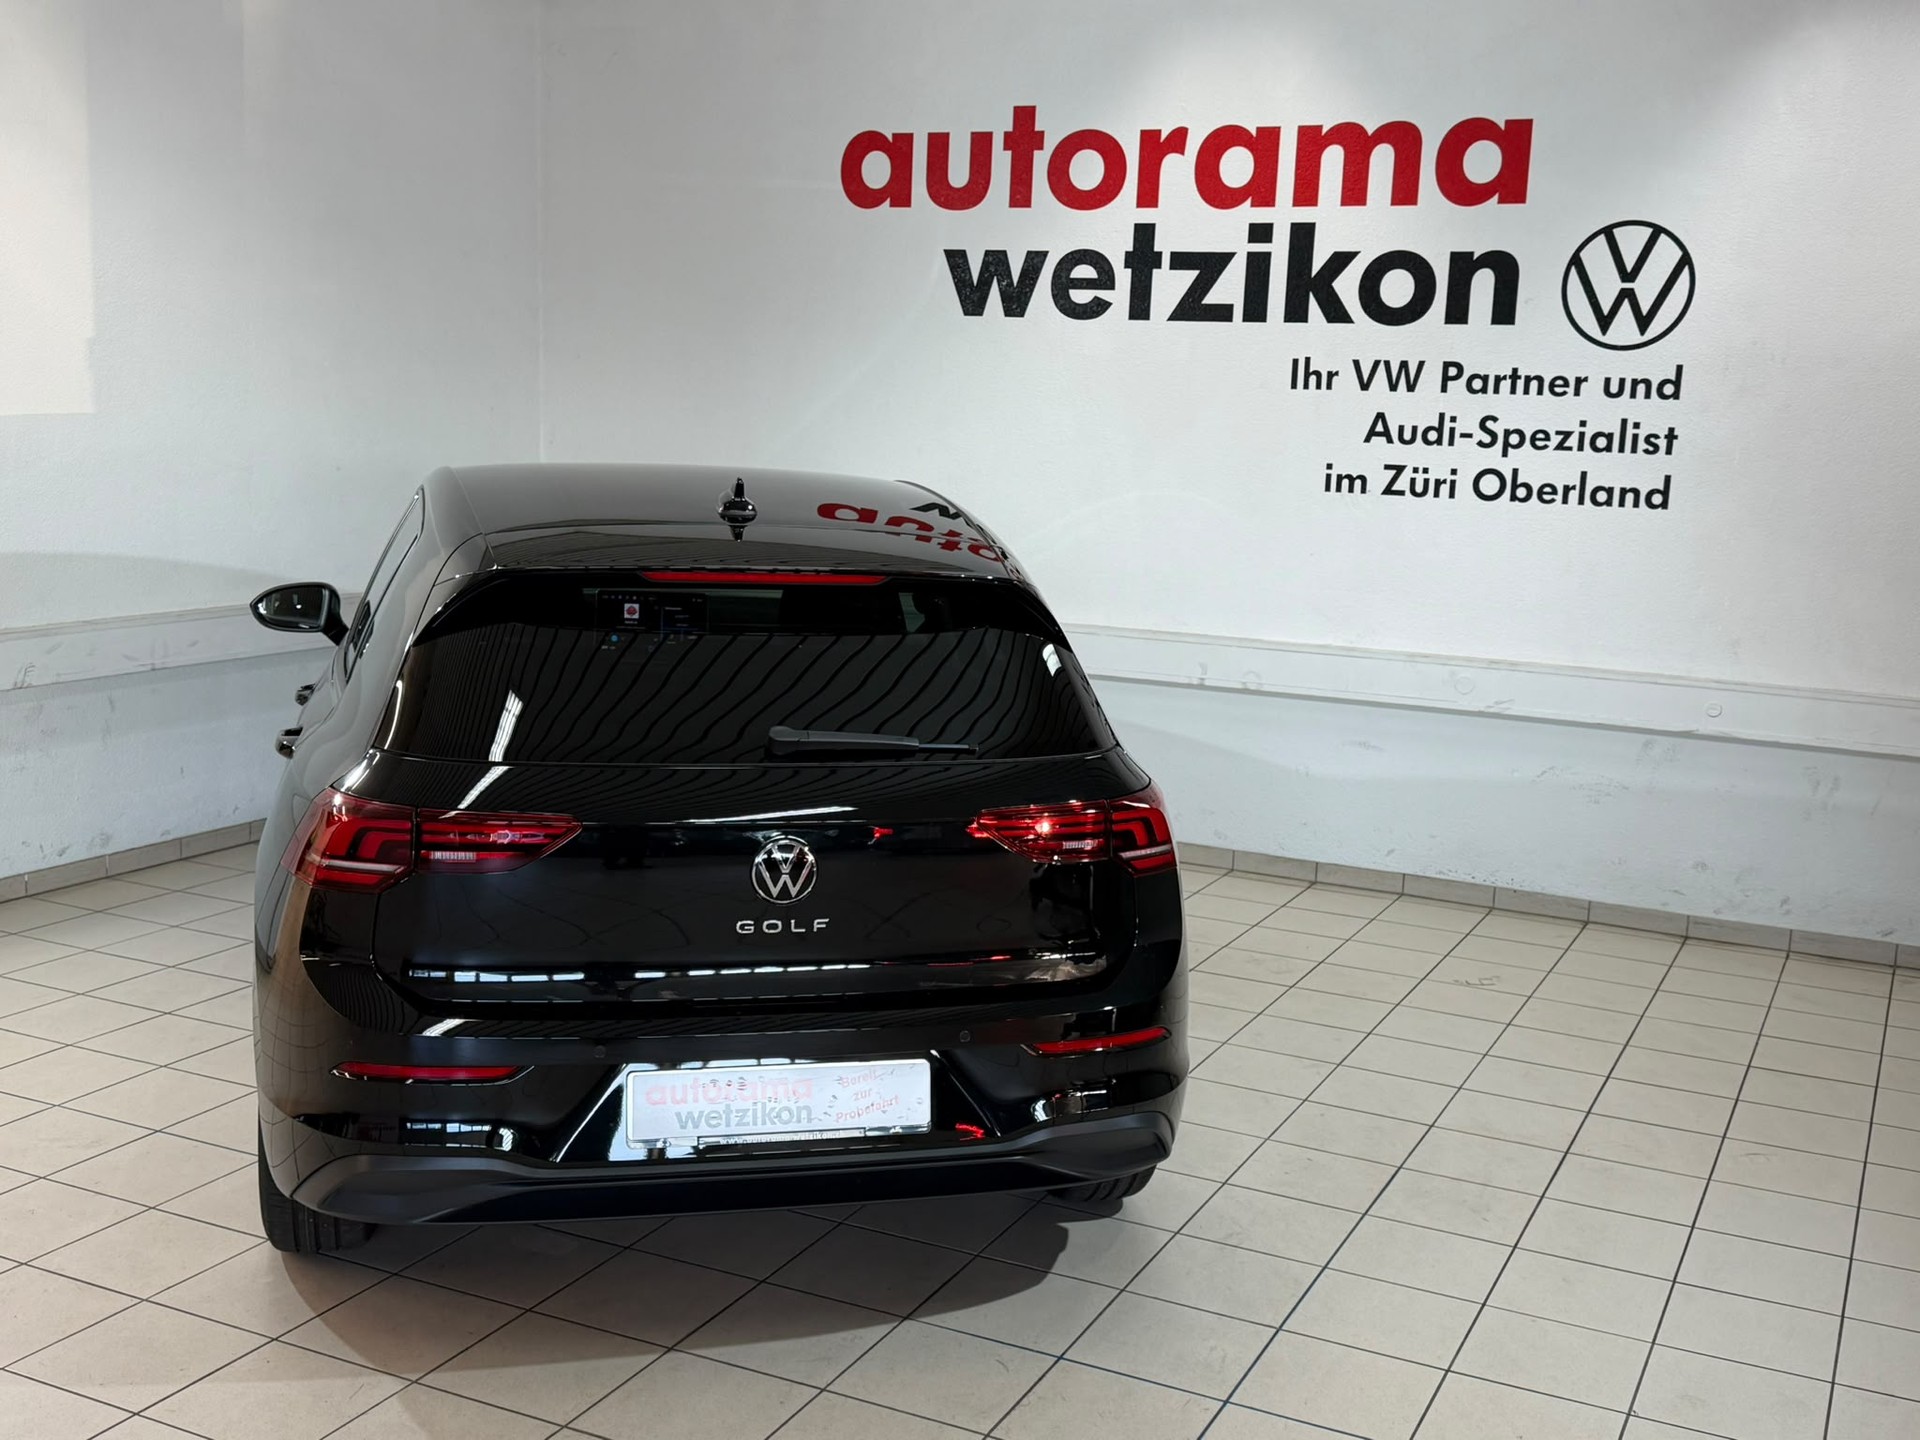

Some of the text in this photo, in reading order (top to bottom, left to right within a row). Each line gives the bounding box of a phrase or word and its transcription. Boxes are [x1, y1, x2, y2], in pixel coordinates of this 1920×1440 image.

[840, 105, 1533, 211] autorama
[943, 222, 1520, 327] wetzikon
[1290, 356, 1684, 401] Ihr VW Partner und
[1363, 411, 1679, 458] Audi-Spezialist
[1324, 463, 1672, 510] im Züri Oberland
[735, 917, 830, 935] GOLF
[644, 1075, 815, 1106] autorama
[852, 1088, 873, 1102] zur
[674, 1100, 813, 1131] wetzikon
